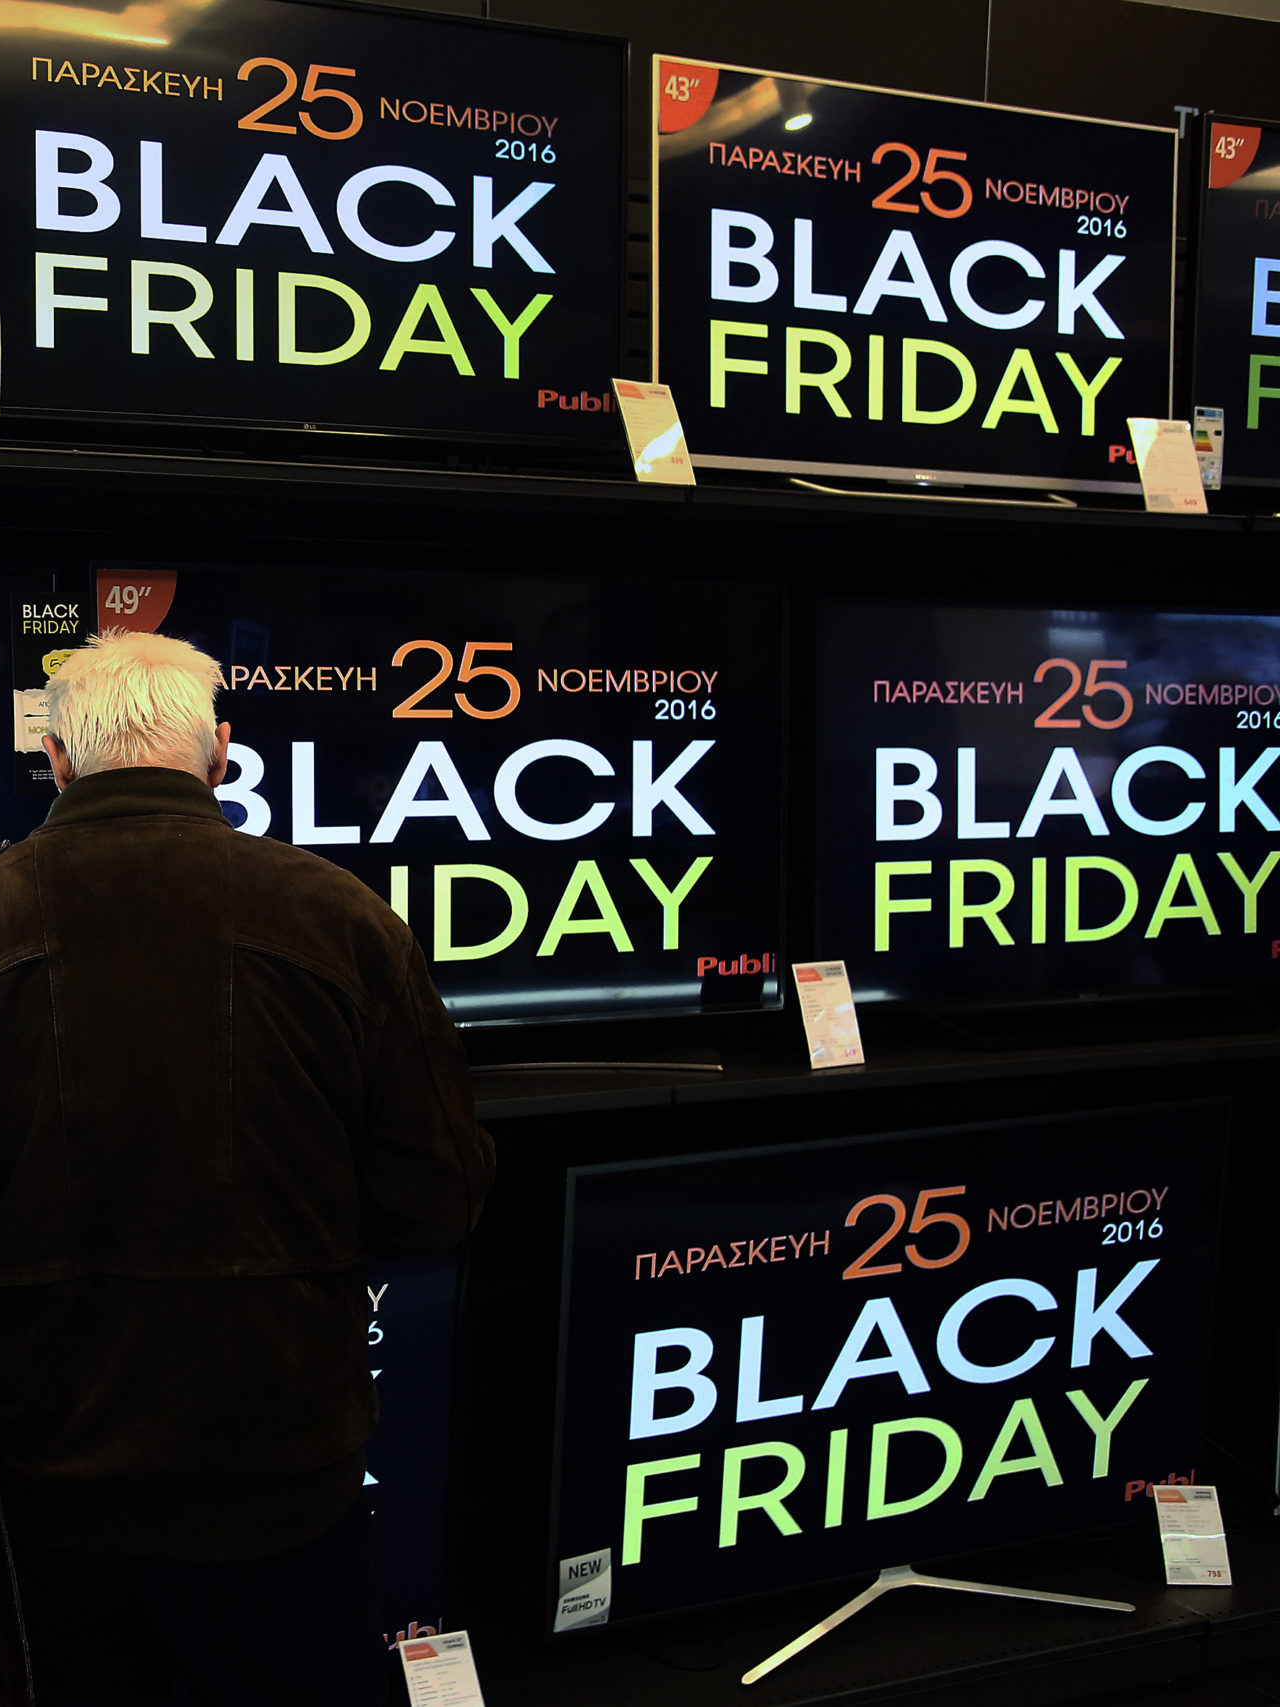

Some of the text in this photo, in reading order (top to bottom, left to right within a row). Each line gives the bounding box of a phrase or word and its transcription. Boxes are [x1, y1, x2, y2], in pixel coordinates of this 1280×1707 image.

[31, 57, 224, 102] ΠΑΡΑΣΚΕΥΗ
[236, 56, 364, 140] 25
[380, 97, 558, 139] ΝΟΕΜΒΡΙΟΥ
[494, 138, 556, 164] 2016
[708, 142, 861, 183] ΠΑΡΑΣΚΕΥΗ
[35, 130, 556, 275] BLACK
[871, 141, 973, 219] 25
[985, 178, 1129, 215] ΝΟΕΜΒΡΙΟΥ
[1076, 215, 1128, 238] 2016
[710, 208, 1127, 340] BLACK
[35, 252, 553, 380] FRIDAY
[710, 319, 1123, 437] FRIDAY
[23, 604, 79, 618] BLACK
[23, 620, 79, 634] FRIDAY
[391, 639, 521, 720] 25
[537, 668, 718, 693] ΝΟΕΜΒΡΙΟΥ
[873, 680, 1023, 705] ΠΑΡΑΣΚΕΥΗ
[1032, 657, 1134, 730] 25
[654, 699, 716, 721] 2016
[875, 744, 1280, 842] BLACK
[874, 850, 1280, 952] FRIDAY
[841, 1185, 971, 1280] 25
[987, 1186, 1170, 1233] ΝΟΕΜΒΡΙΟΥ
[1102, 1218, 1164, 1246] 2016
[635, 1229, 831, 1280] ΠΑΡΑΣΚΕΥΗ
[629, 1259, 1162, 1441] BLACK
[621, 1378, 1150, 1566] FRIDAY
[568, 1558, 602, 1580] NEW
